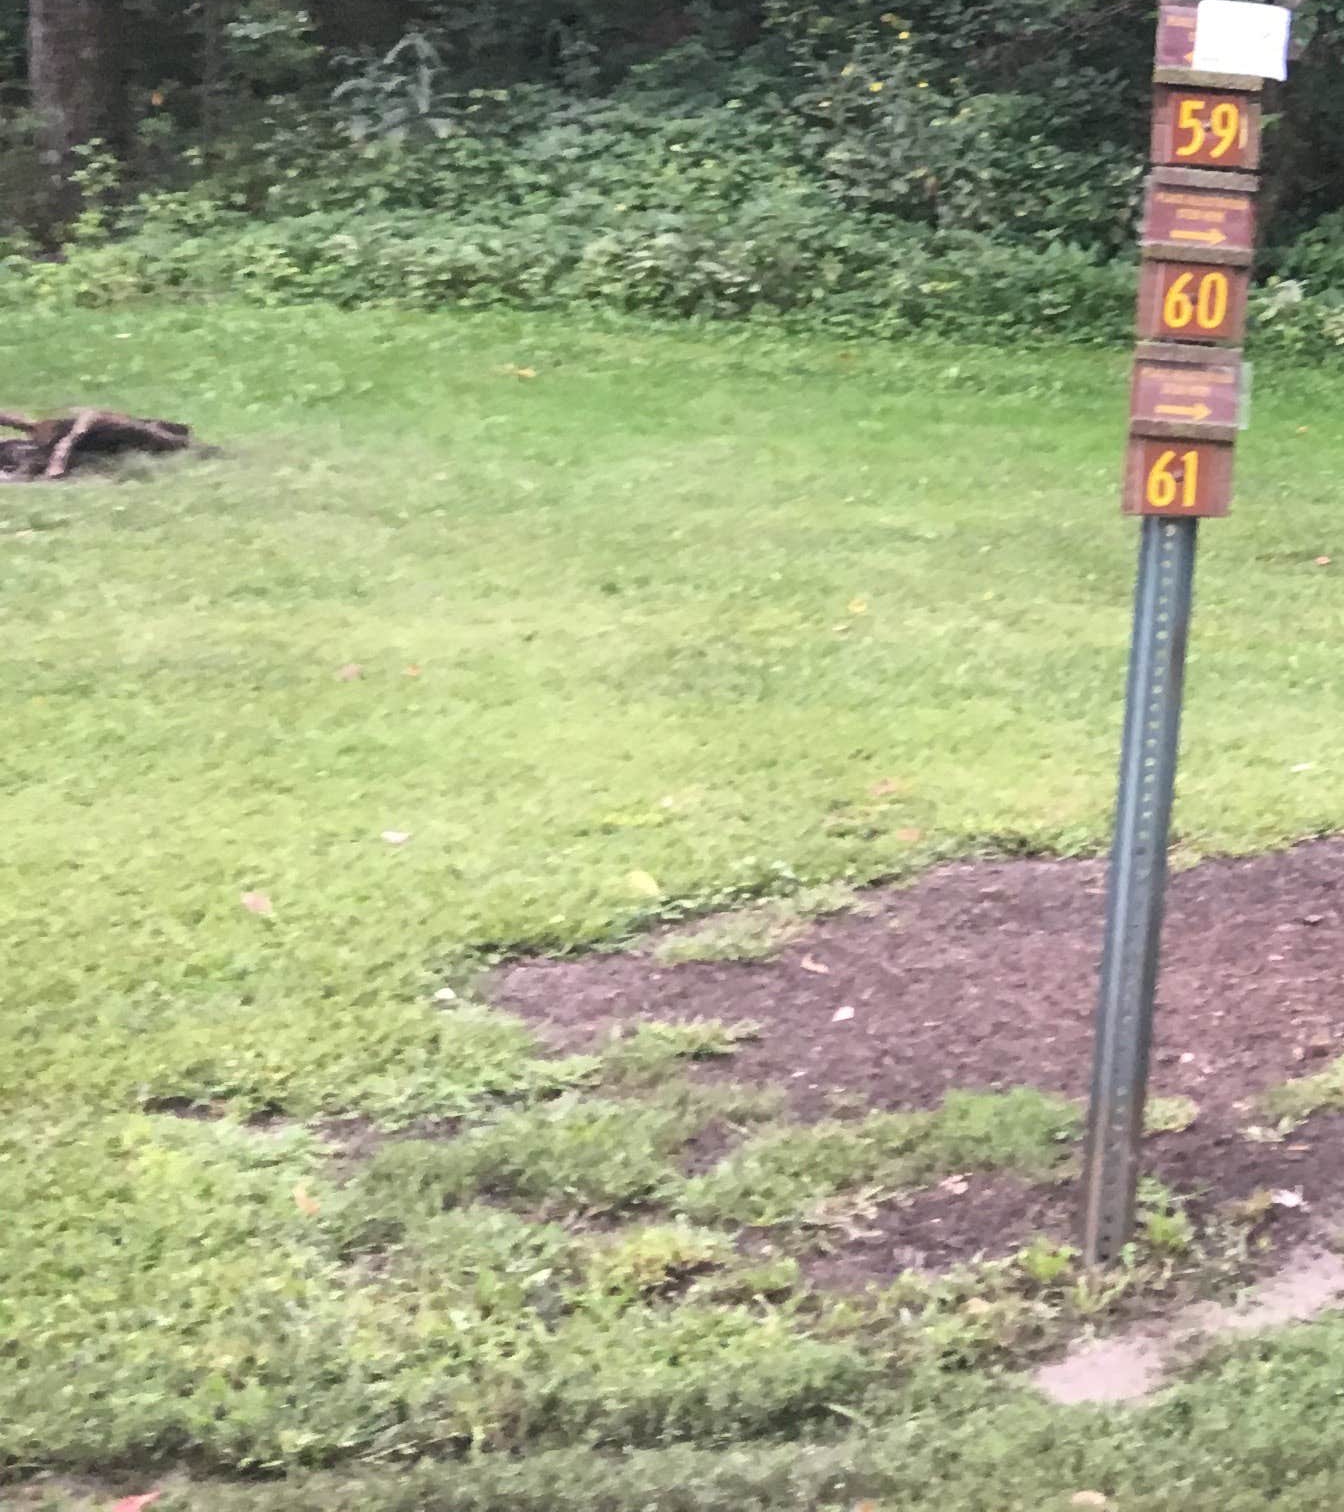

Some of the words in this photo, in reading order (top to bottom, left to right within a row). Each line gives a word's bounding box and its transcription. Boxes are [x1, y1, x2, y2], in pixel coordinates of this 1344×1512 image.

[1176, 99, 1240, 158] 59
[1163, 271, 1228, 329] 60
[1146, 450, 1198, 507] 61
